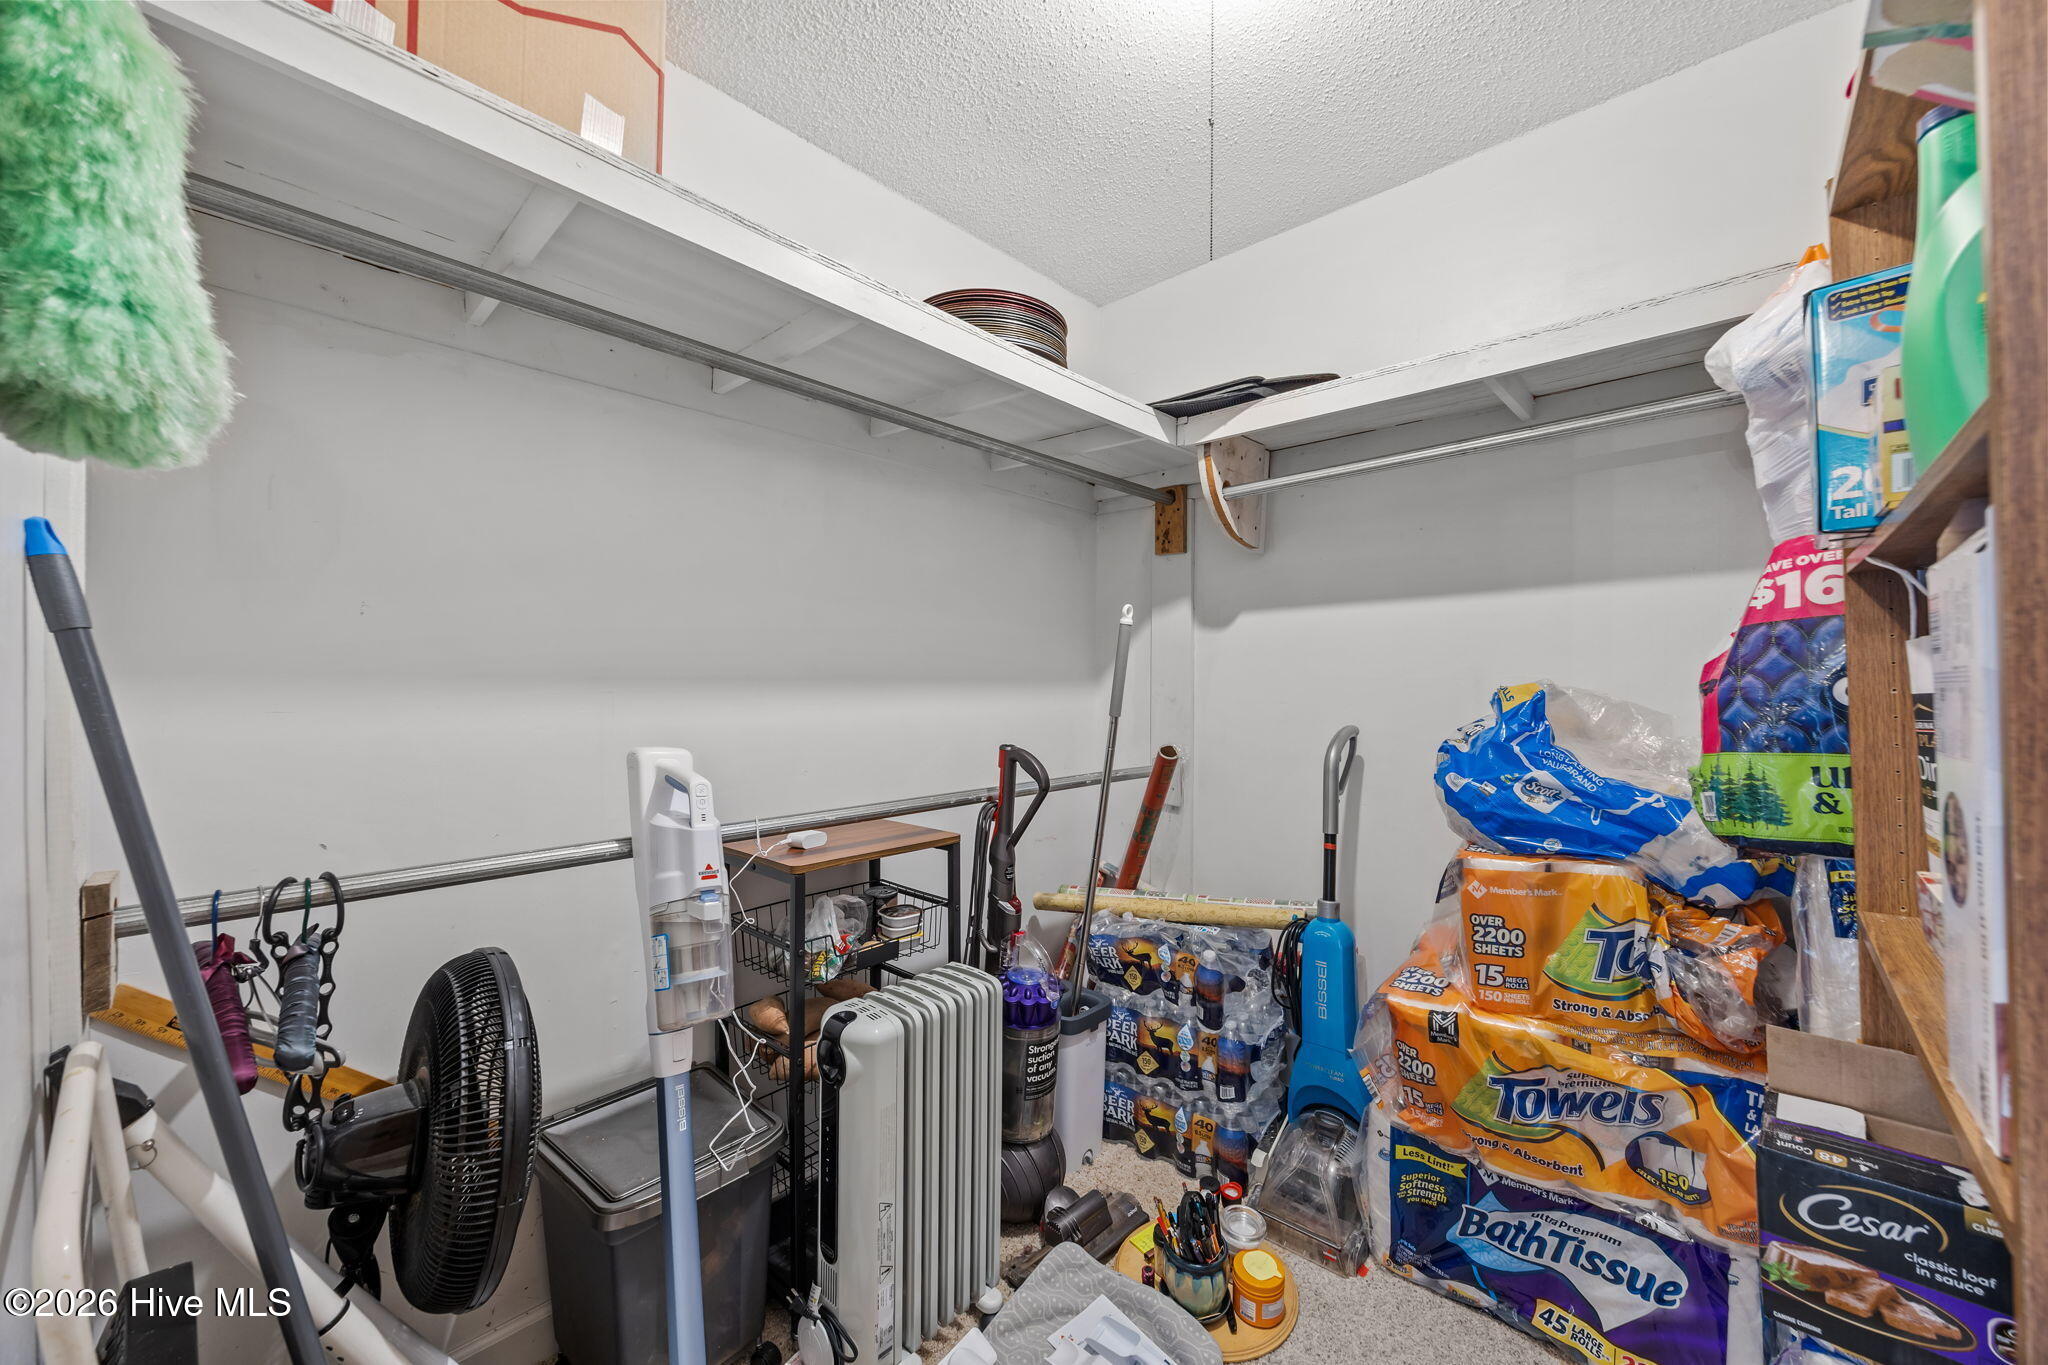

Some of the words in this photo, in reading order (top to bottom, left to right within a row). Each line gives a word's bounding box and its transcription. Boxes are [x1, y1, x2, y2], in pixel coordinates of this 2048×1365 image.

[1833, 502, 1868, 520] Tall
[1524, 780, 1562, 799] Scott
[1489, 886, 1533, 897] Member's
[1471, 914, 1503, 927] OVER
[1473, 928, 1525, 945] 2200
[1475, 943, 1524, 957] SHEETS
[1400, 972, 1449, 989] 2200
[1475, 964, 1504, 986] 15
[1505, 976, 1529, 984] MEGA
[1391, 979, 1443, 997] SHEETS
[1479, 989, 1503, 1002] 150
[1552, 998, 1598, 1018] Strong
[1600, 1006, 1613, 1019] &
[1027, 1050, 1055, 1064] suction
[1396, 1041, 1419, 1058] OVER
[1027, 1064, 1037, 1073] of
[1038, 1061, 1053, 1071] any
[1398, 1052, 1434, 1080] 2200
[1403, 1086, 1425, 1108] 15
[1488, 1075, 1666, 1126] Towels
[1747, 1110, 1757, 1121] &
[1195, 1119, 1214, 1132] 40
[1403, 1147, 1425, 1160] Less
[1776, 1140, 1813, 1155] Count
[1501, 1143, 1512, 1151] &
[1513, 1147, 1585, 1177] Absorbent
[1818, 1151, 1844, 1163] 48
[1401, 1173, 1441, 1183] Superior
[1500, 1176, 1548, 1197] Member's
[1658, 1168, 1690, 1191] 150
[1400, 1180, 1446, 1194] Softness
[1406, 1196, 1421, 1204] you
[1421, 1198, 1438, 1207] need
[1407, 1188, 1448, 1204] Strength
[1797, 1192, 1931, 1244] Cesar
[1530, 1212, 1558, 1225] ultra
[1558, 1220, 1622, 1248] Premium
[1458, 1204, 1546, 1260] Bath
[1548, 1230, 1683, 1307] Tissue
[1903, 1252, 1959, 1277] classic
[1962, 1267, 1998, 1290] loaf
[1915, 1265, 1932, 1277] in
[1934, 1273, 1985, 1297] sauce
[1537, 1307, 1570, 1335] 45
[1570, 1332, 1601, 1359] ROLLS
[1571, 1324, 1604, 1351] LARGE
